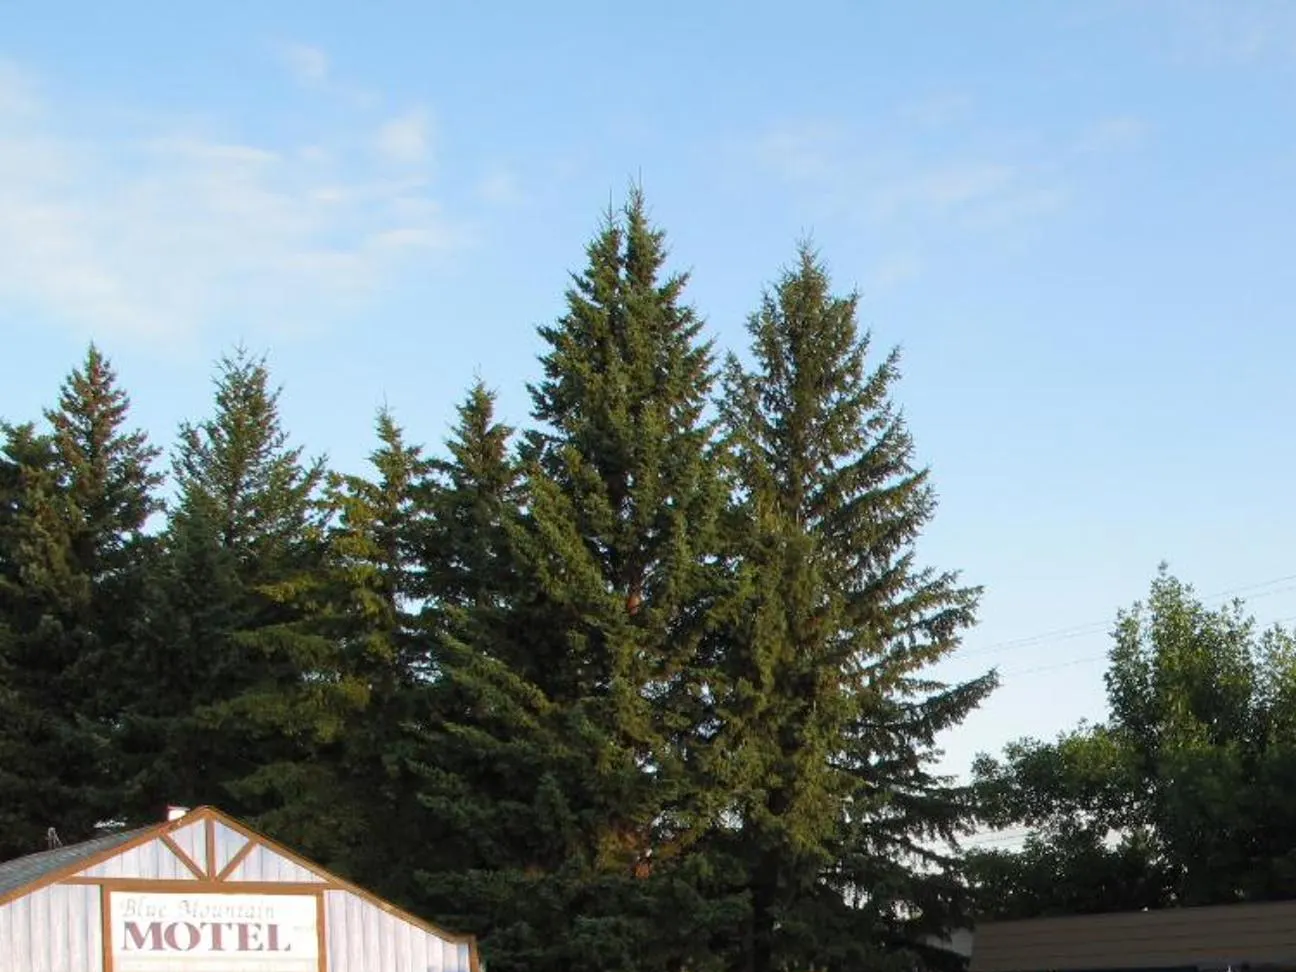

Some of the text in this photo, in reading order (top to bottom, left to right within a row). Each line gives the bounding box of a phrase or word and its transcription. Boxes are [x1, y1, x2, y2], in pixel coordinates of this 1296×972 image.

[120, 896, 275, 920] Blue Mountain
[121, 920, 292, 952] MOTEL
